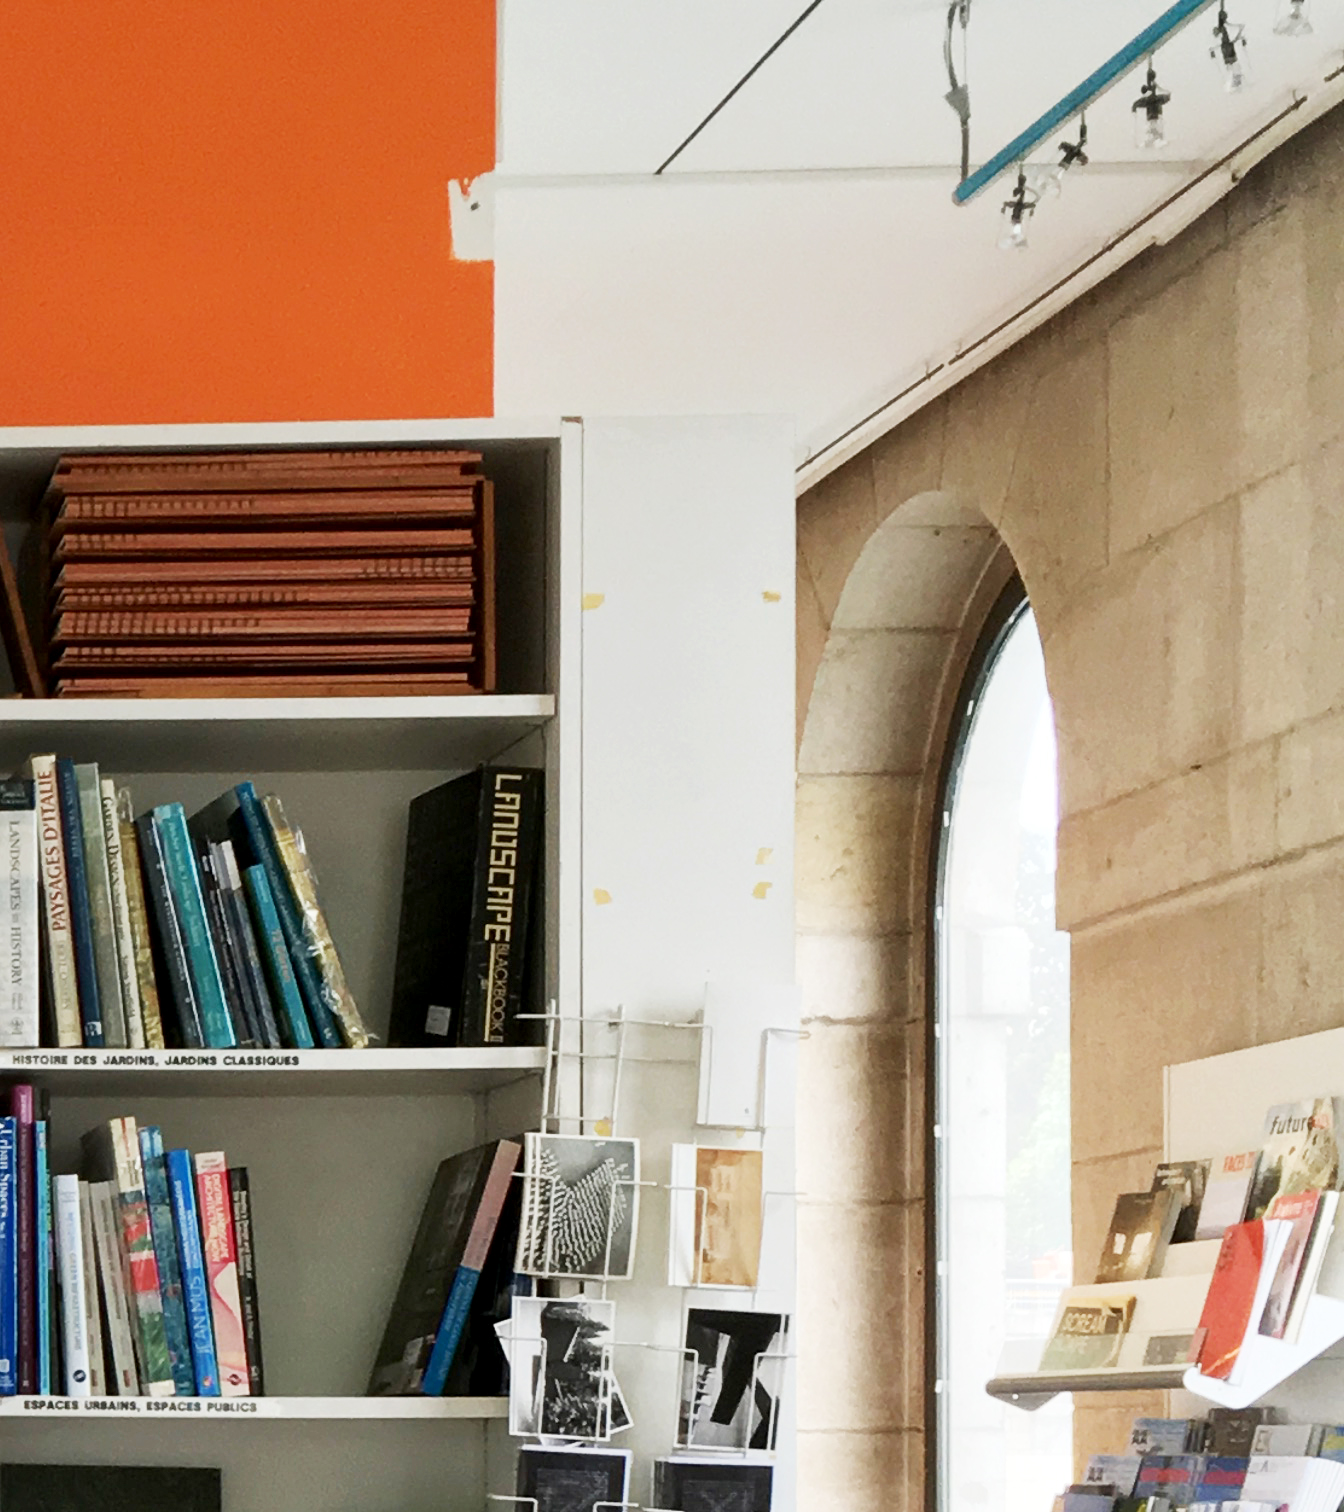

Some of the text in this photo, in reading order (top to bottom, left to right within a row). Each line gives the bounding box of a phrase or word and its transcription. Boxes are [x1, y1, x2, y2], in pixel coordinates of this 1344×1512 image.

[37, 770, 67, 932] PAYSAGES D'ITALIE
[484, 773, 523, 1035] LANDSCAPE BLACKBOOK
[12, 1054, 300, 1067] HISTOIRE DES JARDINS, JARDINS CLASSIQUES
[23, 1399, 257, 1412] ESPACES URBAINS, ESPACES PUBLICS
